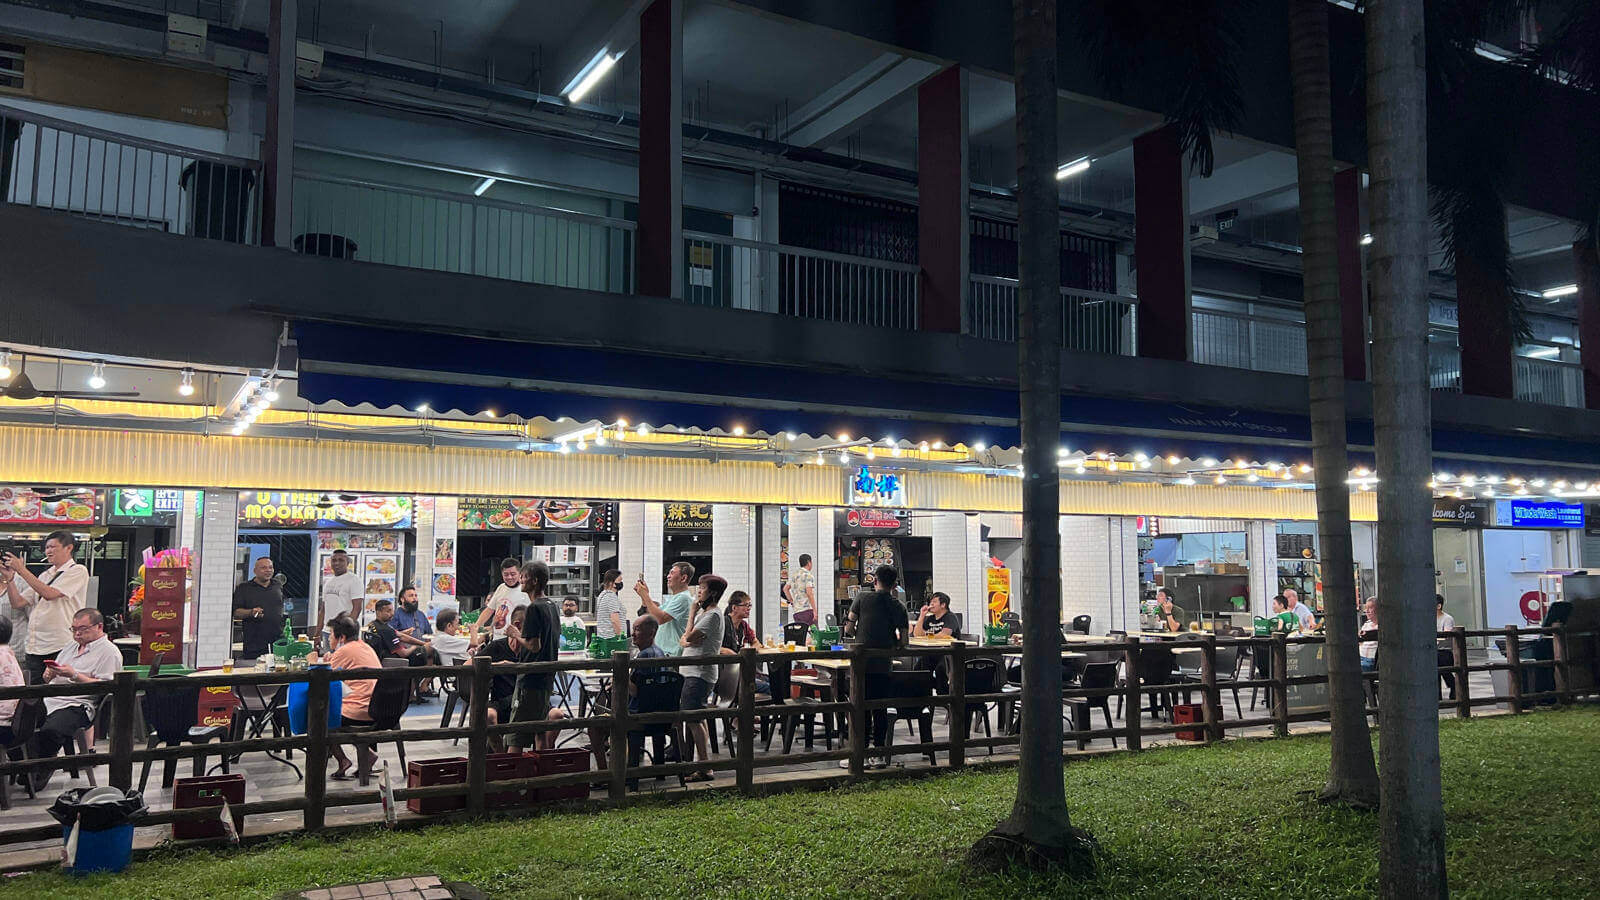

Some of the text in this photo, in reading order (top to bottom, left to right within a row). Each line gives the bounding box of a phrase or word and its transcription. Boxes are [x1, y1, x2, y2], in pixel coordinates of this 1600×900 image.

[1219, 218, 1234, 230] EXIT
[155, 498, 178, 508] EXIT
[245, 504, 336, 520] MOOKATA
[1432, 503, 1476, 524] lcome Spa
[152, 579, 178, 590] Carlsberg
[151, 609, 177, 620] Carlsberg
[150, 641, 175, 652] Carlsberg
[203, 715, 231, 727] Carlsberg
